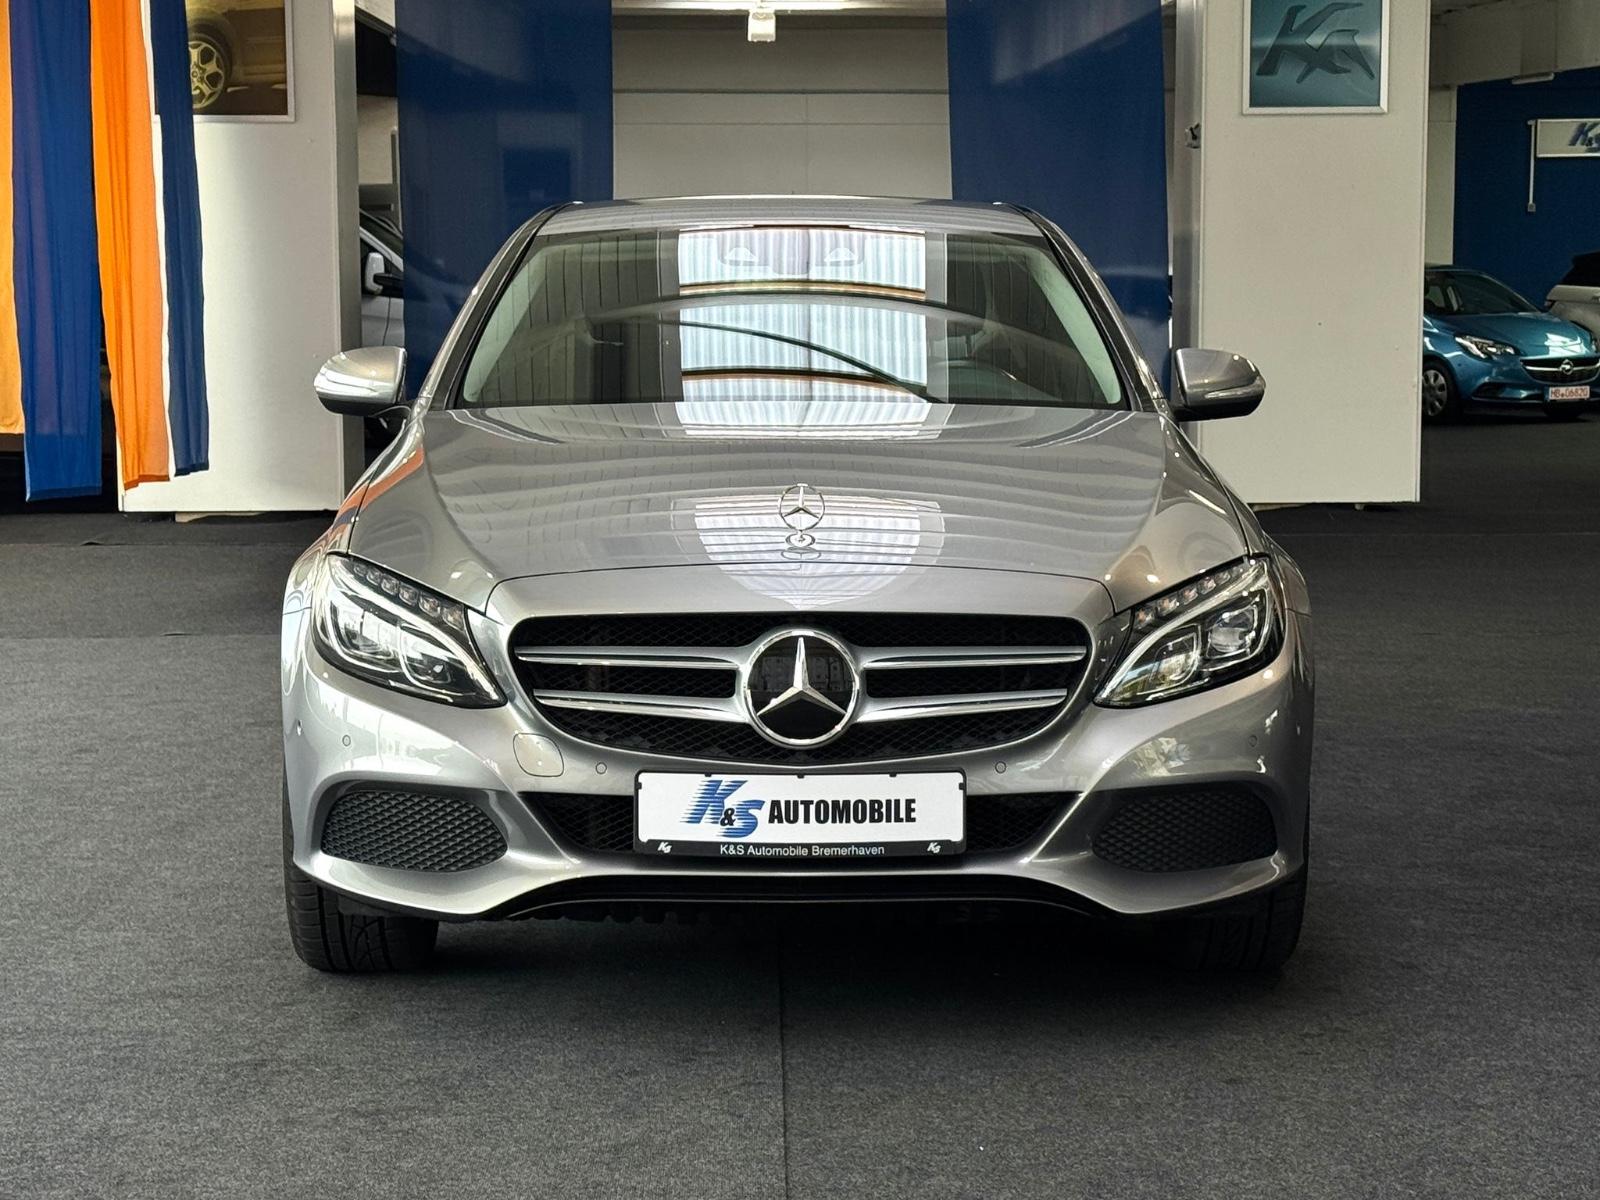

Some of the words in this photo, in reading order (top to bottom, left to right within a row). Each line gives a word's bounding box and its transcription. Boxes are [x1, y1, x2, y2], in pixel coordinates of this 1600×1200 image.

[768, 798, 916, 824] AUTOMOBILE
[720, 844, 744, 855] K&S
[747, 844, 809, 856] Automobile
[811, 845, 885, 856] Bremerhaven
